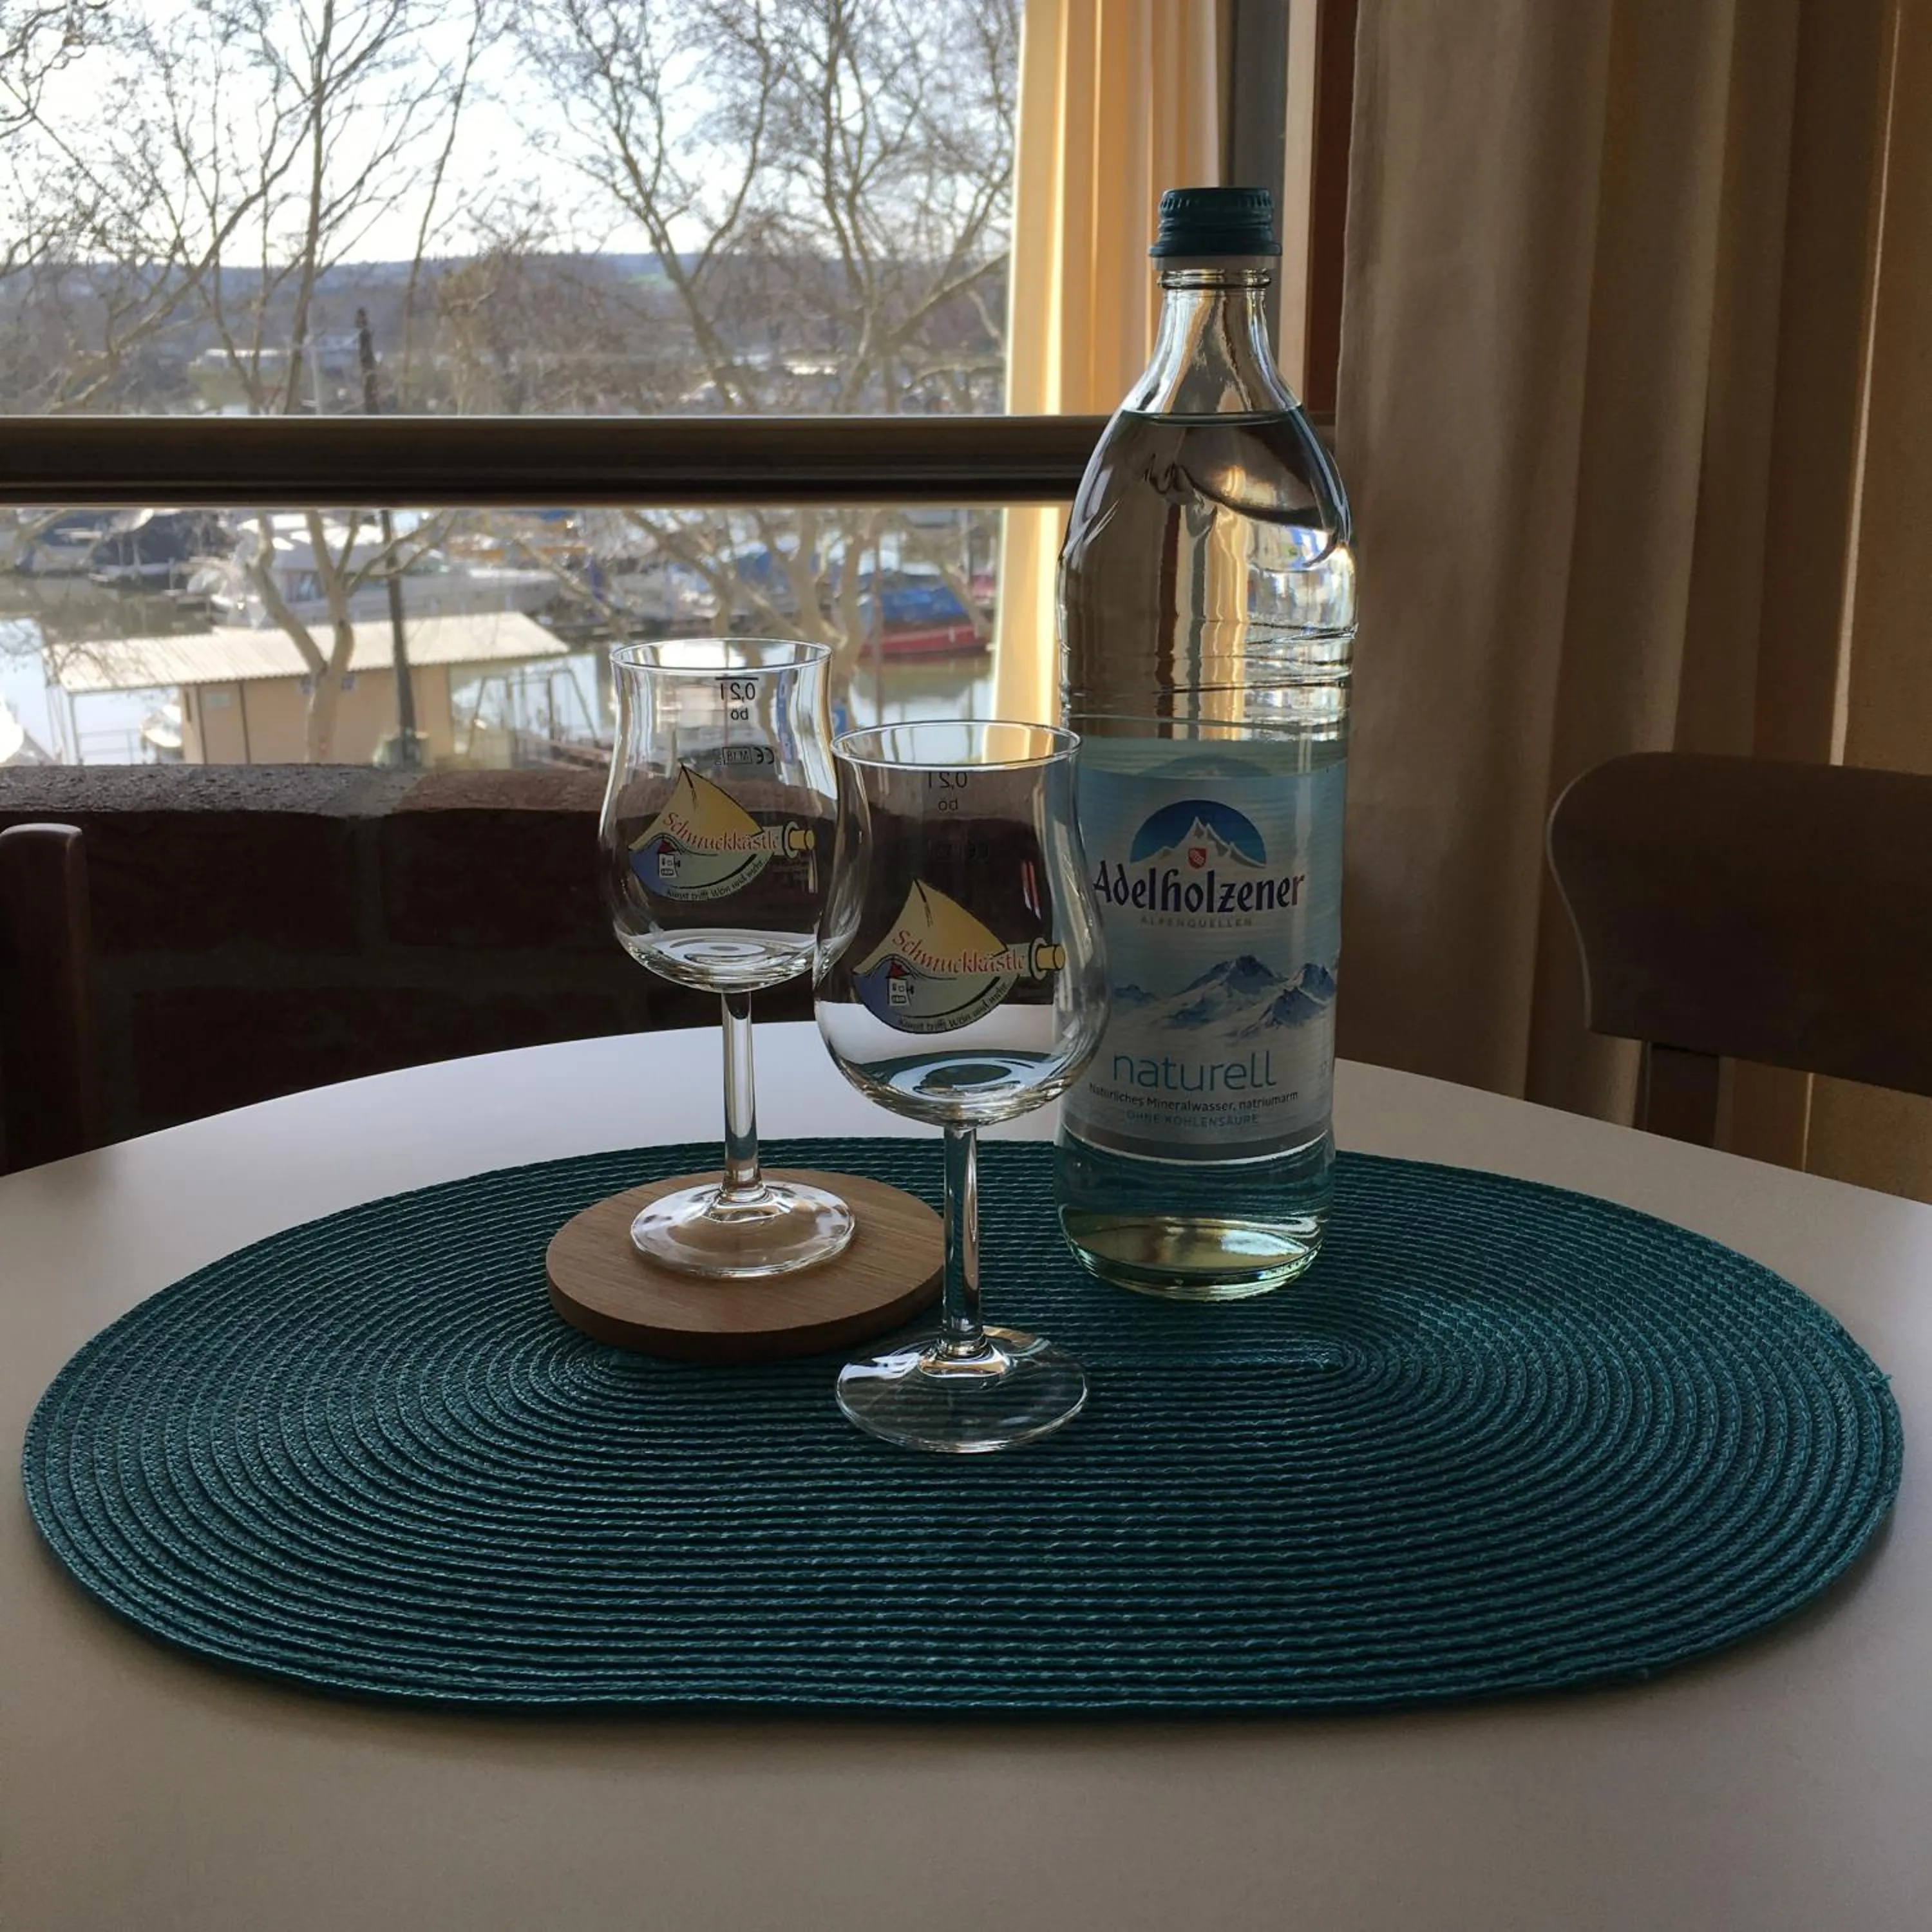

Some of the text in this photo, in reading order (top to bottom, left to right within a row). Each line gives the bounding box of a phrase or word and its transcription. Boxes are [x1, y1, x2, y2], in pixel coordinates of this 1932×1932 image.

[1094, 860, 1305, 913] Adelholzener
[1141, 916, 1252, 929] ALPENQUELLEN
[1113, 1050, 1278, 1092] naturell
[1238, 1091, 1298, 1110] natriumarm
[1127, 1110, 1259, 1128] OHNE KOHLENSÄURE
